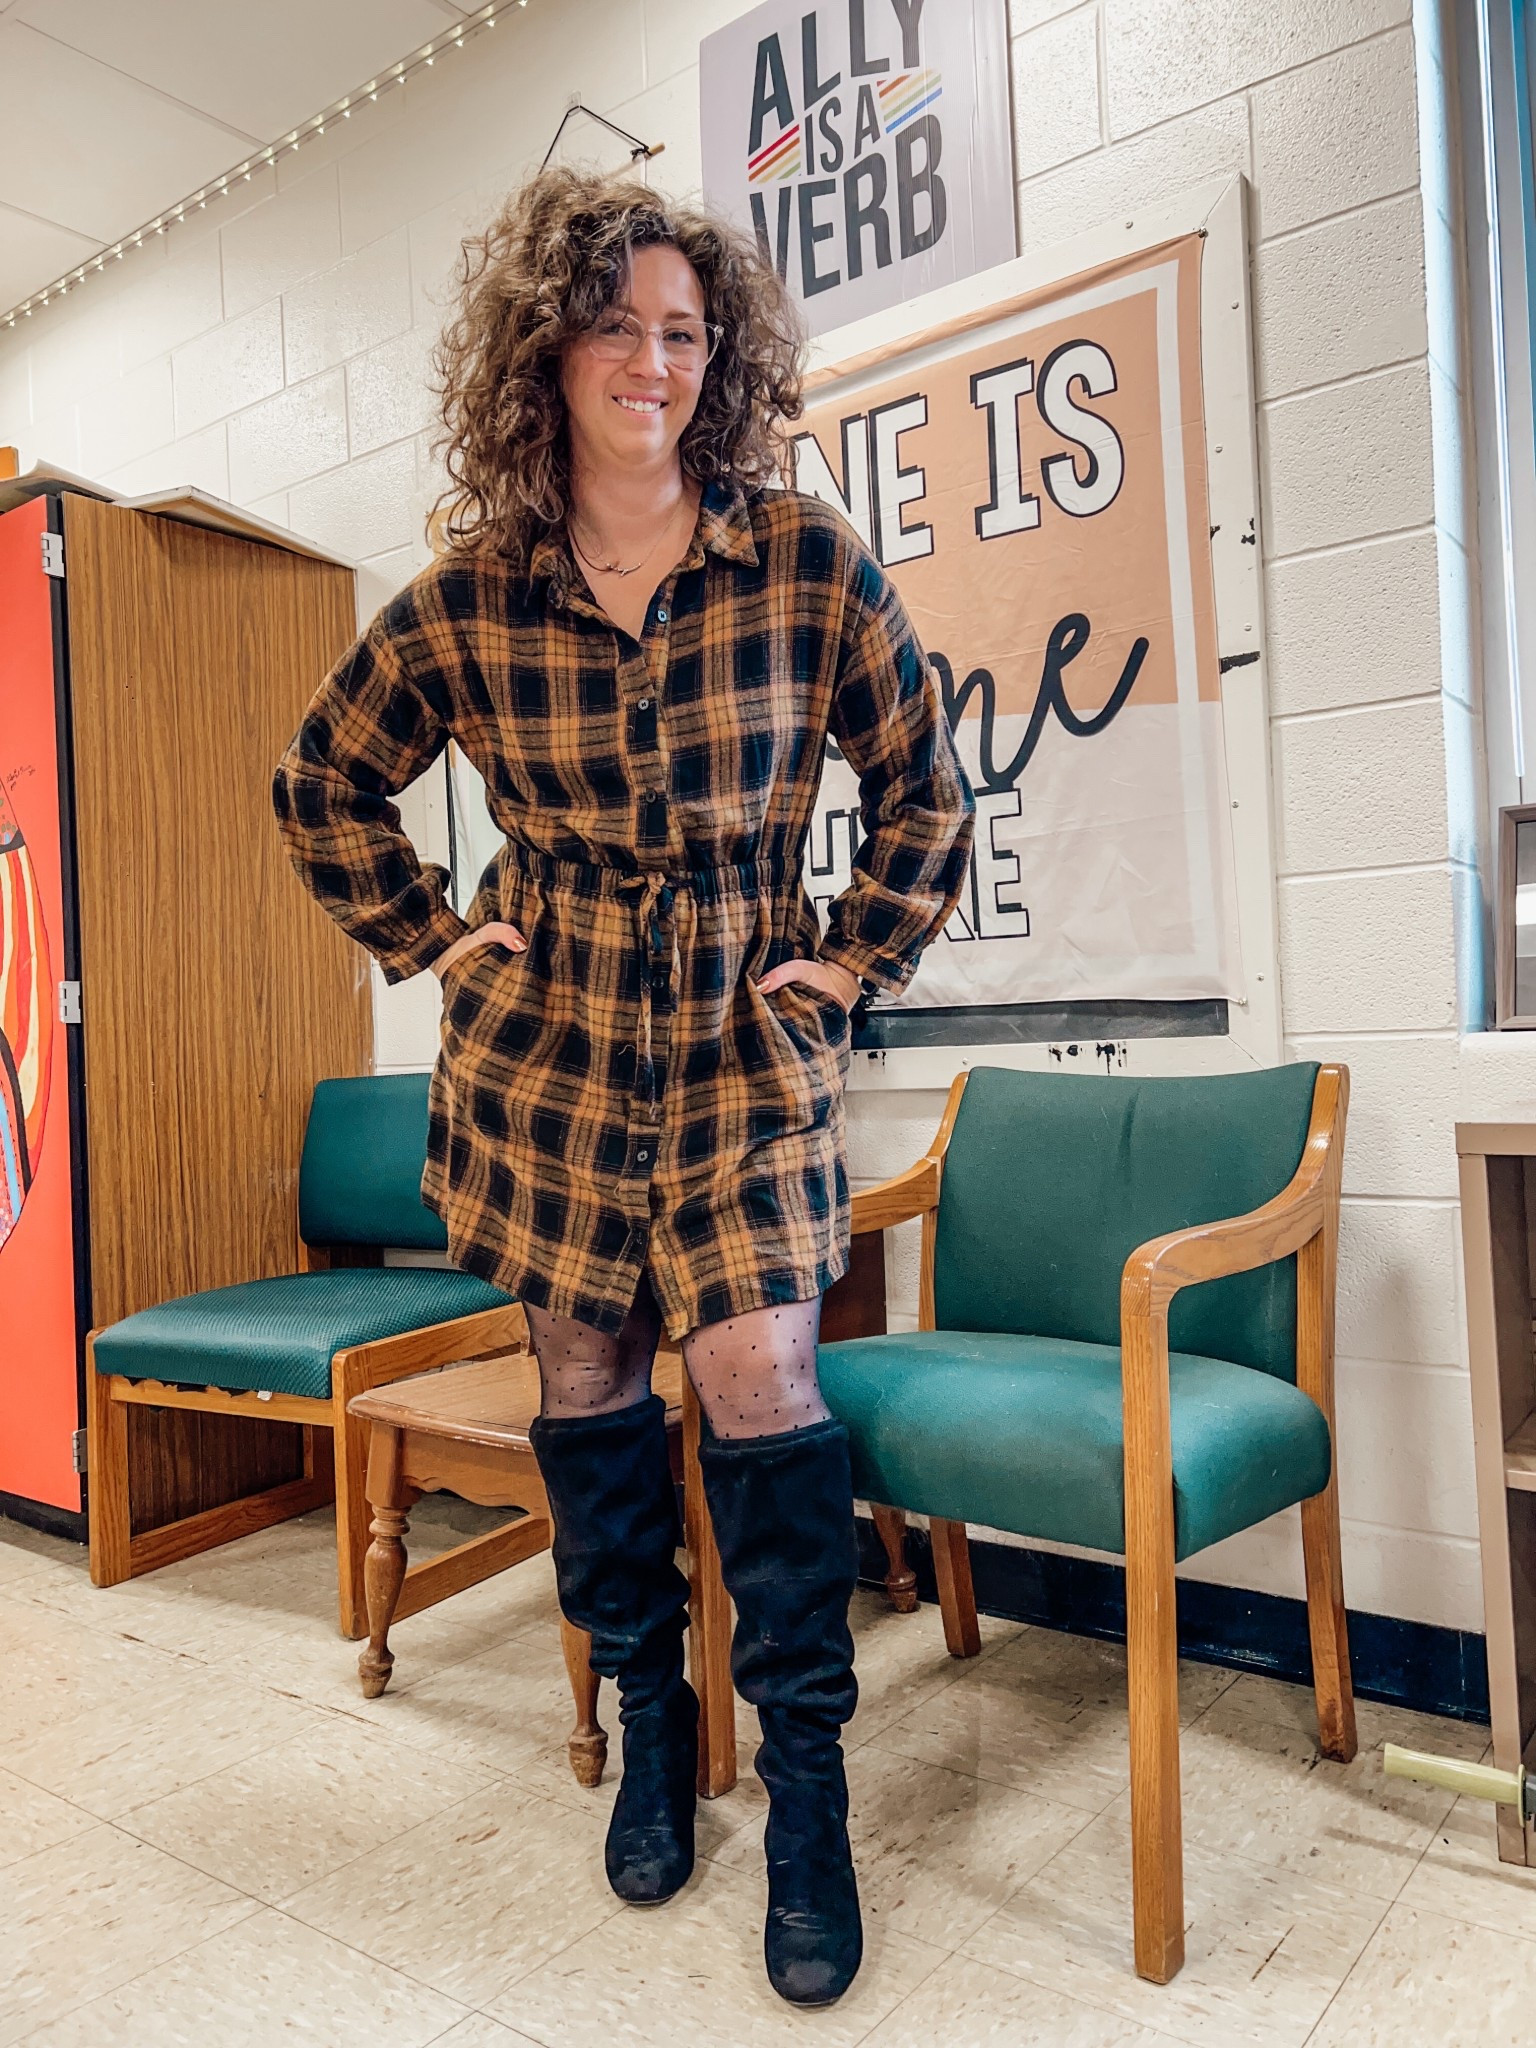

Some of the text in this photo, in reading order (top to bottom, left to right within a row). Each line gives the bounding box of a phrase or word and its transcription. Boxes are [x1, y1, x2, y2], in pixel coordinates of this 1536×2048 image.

[748, 0, 924, 156] ALLY
[804, 84, 880, 175] IS A
[749, 114, 947, 299] VERB
[768, 339, 1125, 568] NE IS
